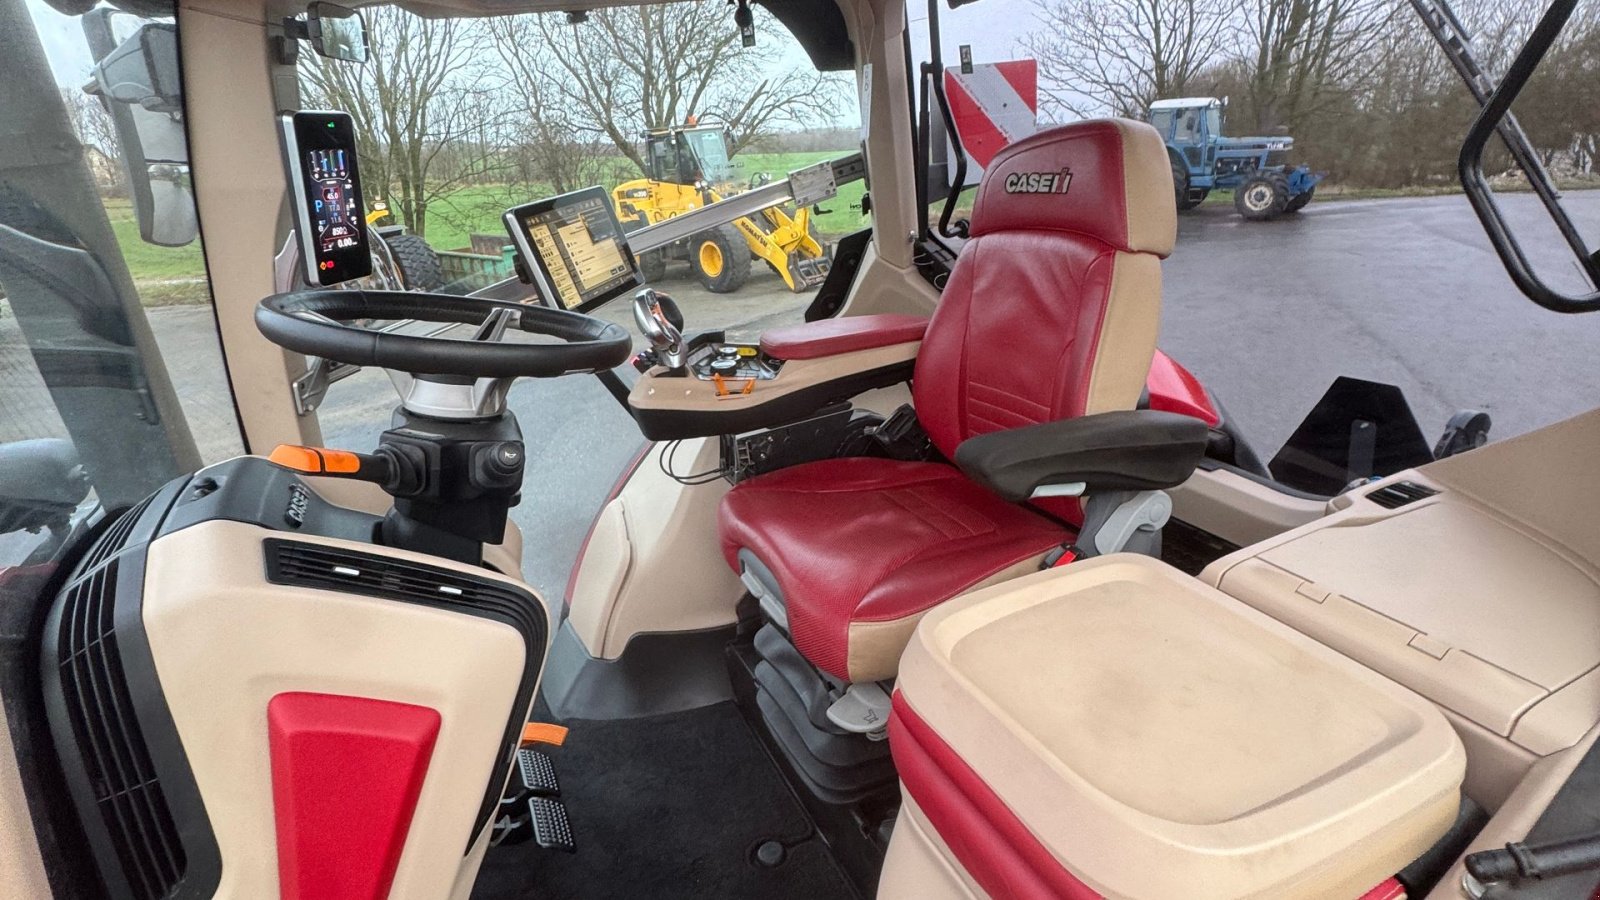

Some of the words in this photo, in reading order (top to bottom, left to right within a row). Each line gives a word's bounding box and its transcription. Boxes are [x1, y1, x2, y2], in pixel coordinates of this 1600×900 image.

[314, 199, 323, 209] P
[741, 220, 768, 248] KOMATSU
[337, 237, 352, 248] 0.00
